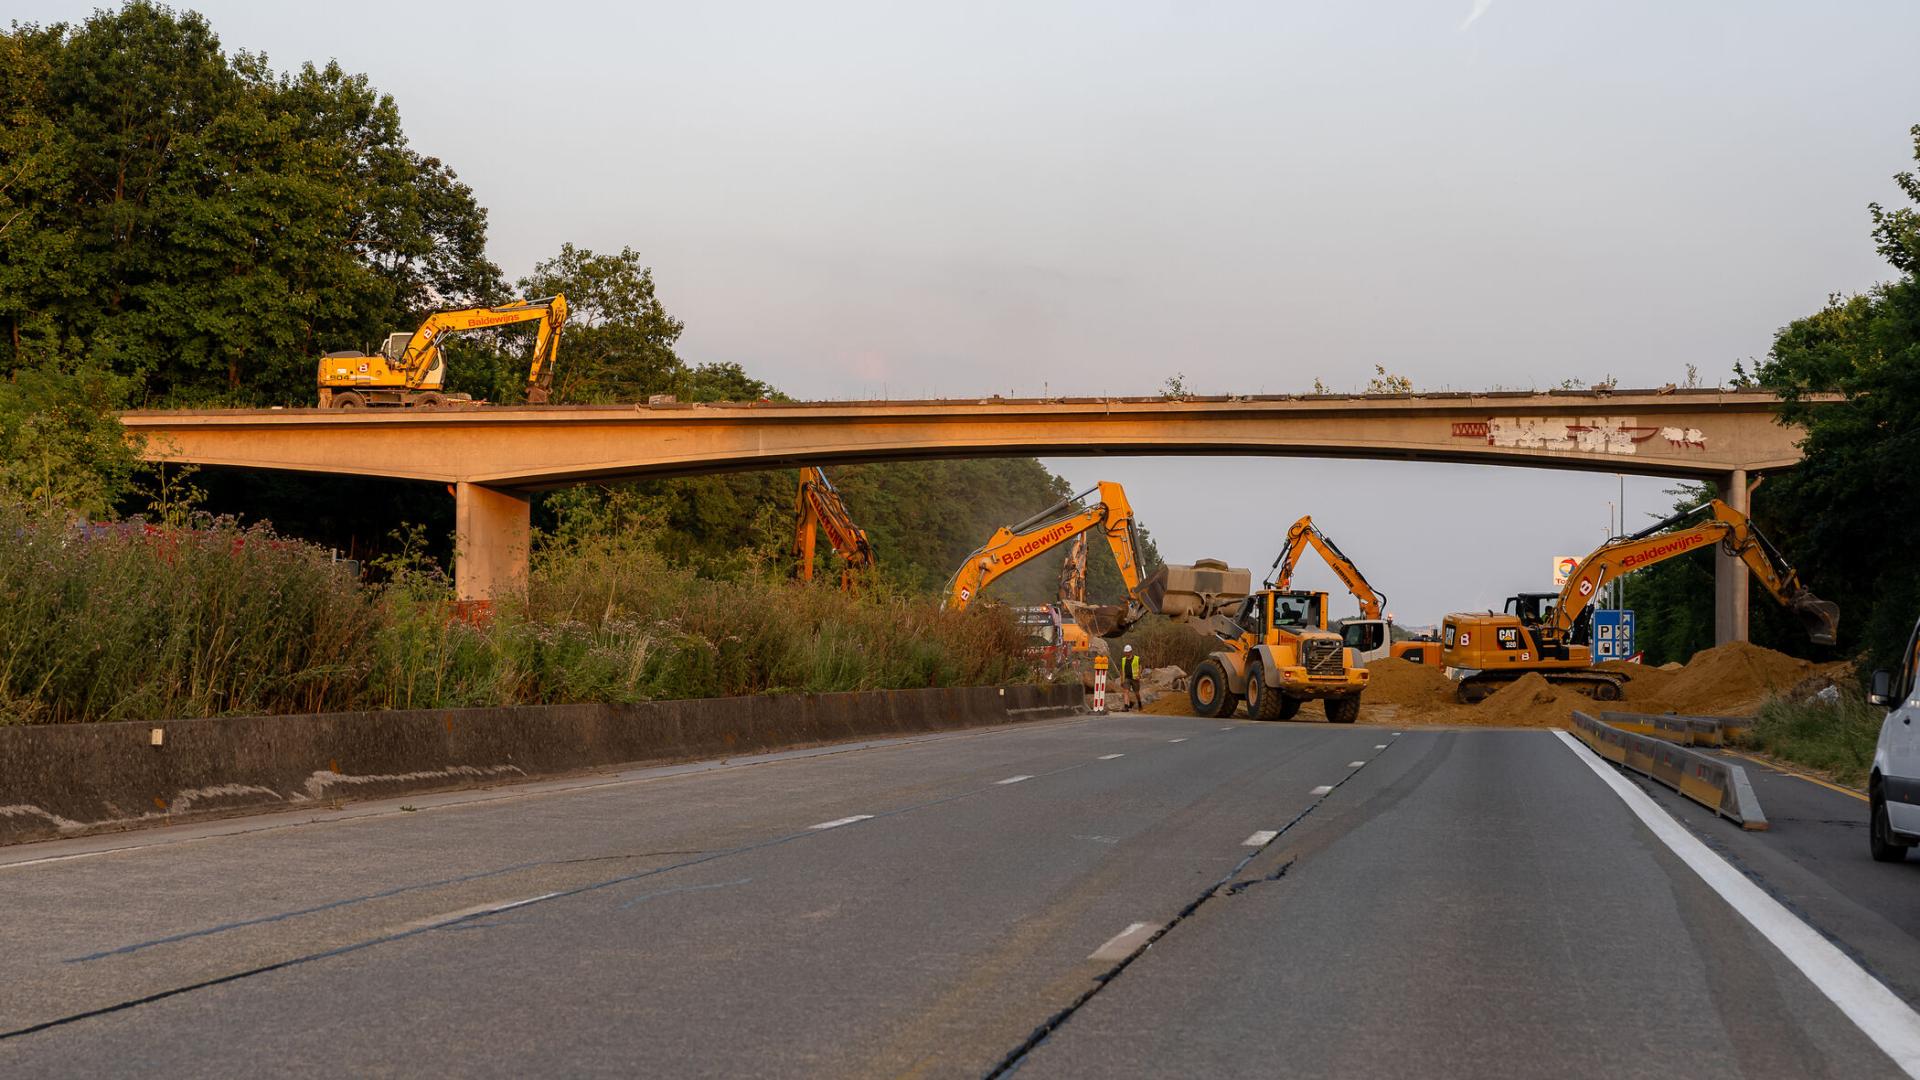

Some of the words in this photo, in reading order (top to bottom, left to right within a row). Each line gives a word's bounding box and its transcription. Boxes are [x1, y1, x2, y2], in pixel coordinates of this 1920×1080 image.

[468, 314, 519, 327] Baldewijns
[1001, 523, 1074, 565] Baldewijns
[1623, 533, 1704, 567] Baldewijns
[1498, 629, 1517, 641] CAT
[1600, 625, 1610, 638] P
[1460, 633, 1470, 646] B
